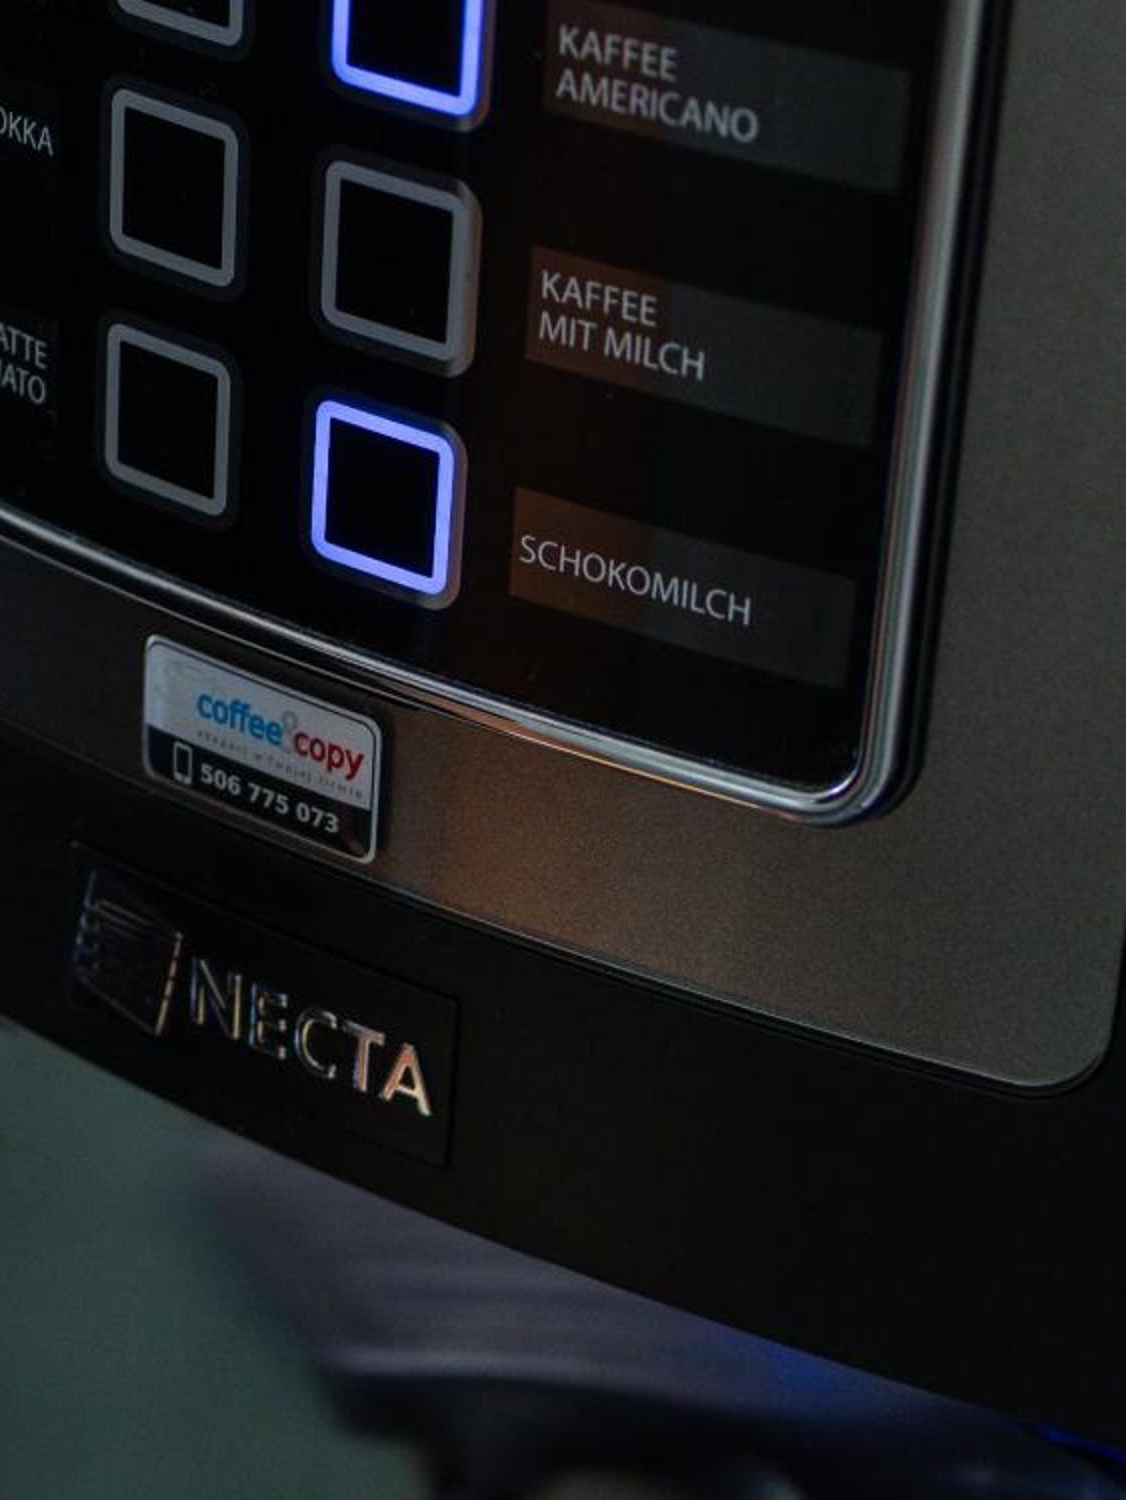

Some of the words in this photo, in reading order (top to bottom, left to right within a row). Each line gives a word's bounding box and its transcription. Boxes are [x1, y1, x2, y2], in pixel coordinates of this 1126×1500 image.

[559, 23, 680, 82] KAFFEE
[555, 68, 760, 144] AMERICANO
[540, 269, 657, 327] KAFFEE
[539, 311, 597, 352] MIT
[603, 327, 705, 383] MILCH
[519, 534, 752, 626] SCHOKOMILCH
[201, 763, 242, 796] 506
[248, 782, 289, 815] 775
[296, 802, 340, 833] 073
[190, 956, 432, 1117] NECTA
